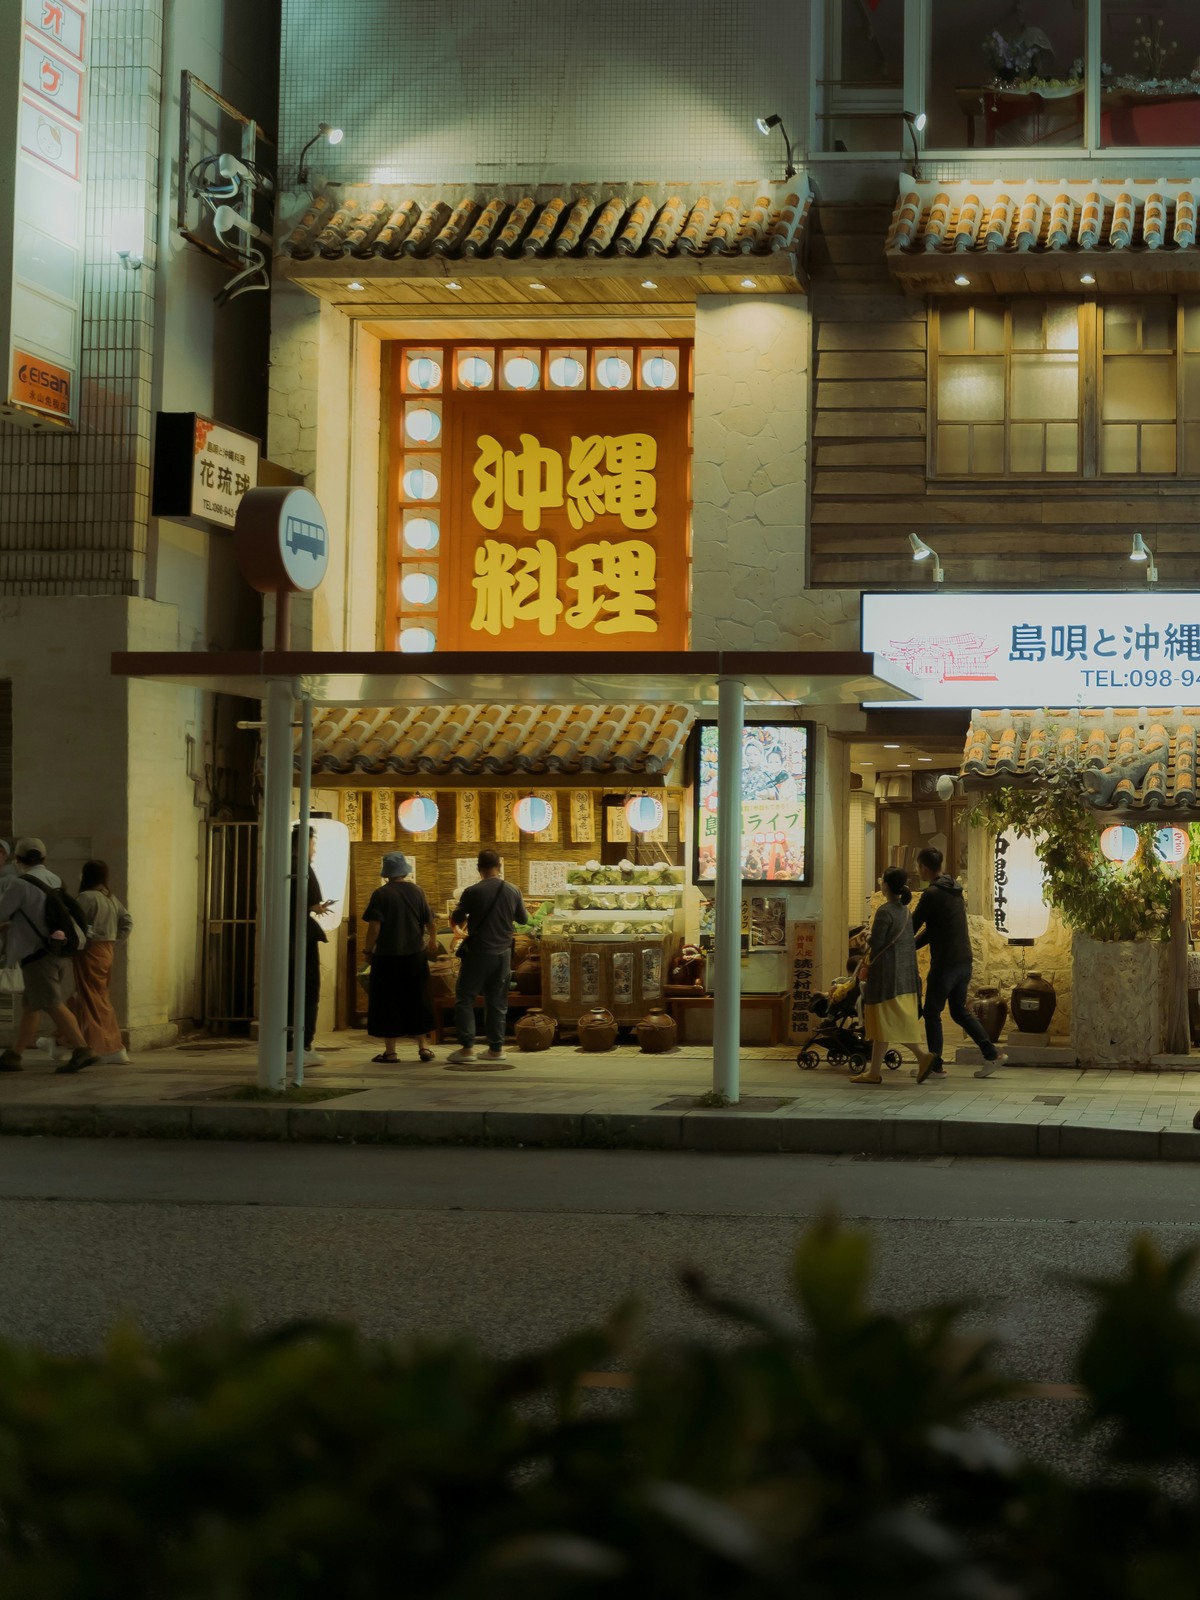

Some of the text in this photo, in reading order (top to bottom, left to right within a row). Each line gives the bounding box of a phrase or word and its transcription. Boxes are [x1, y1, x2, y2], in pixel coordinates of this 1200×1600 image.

[200, 458, 251, 496] 花琉球
[472, 433, 657, 531] 沖縄
[470, 539, 657, 636] 料理
[705, 808, 802, 837] 島ライブ
[1174, 832, 1184, 855] Orion
